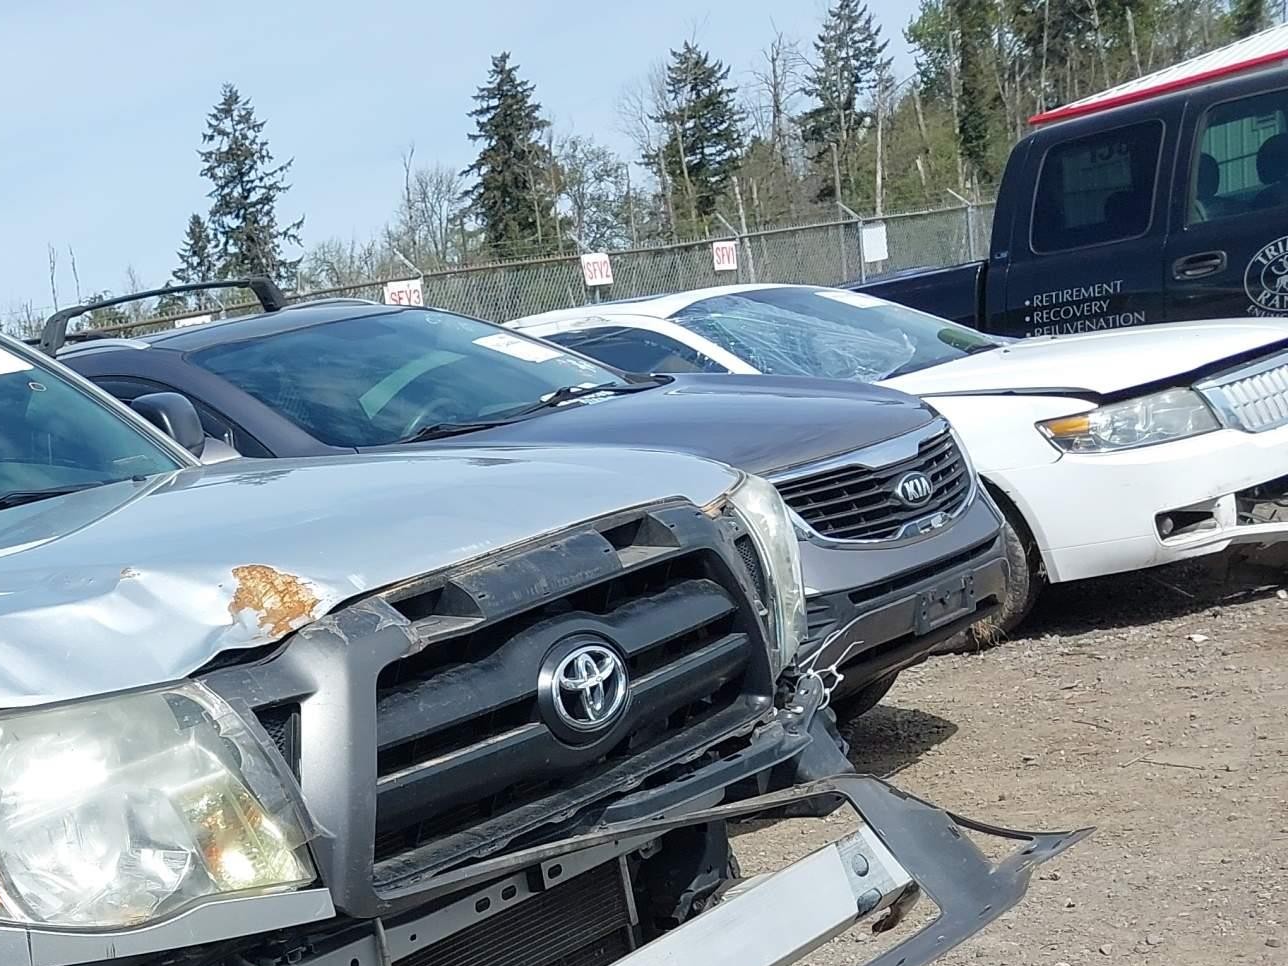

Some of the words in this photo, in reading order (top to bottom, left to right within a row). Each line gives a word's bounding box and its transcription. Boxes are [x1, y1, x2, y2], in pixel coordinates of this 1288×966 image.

[1254, 239, 1288, 265] TRI
[1033, 280, 1123, 307] RETIREMENT
[1033, 299, 1110, 324] RECOVERY
[1034, 311, 1145, 337] REJUVENATION
[903, 476, 931, 500] KIA
